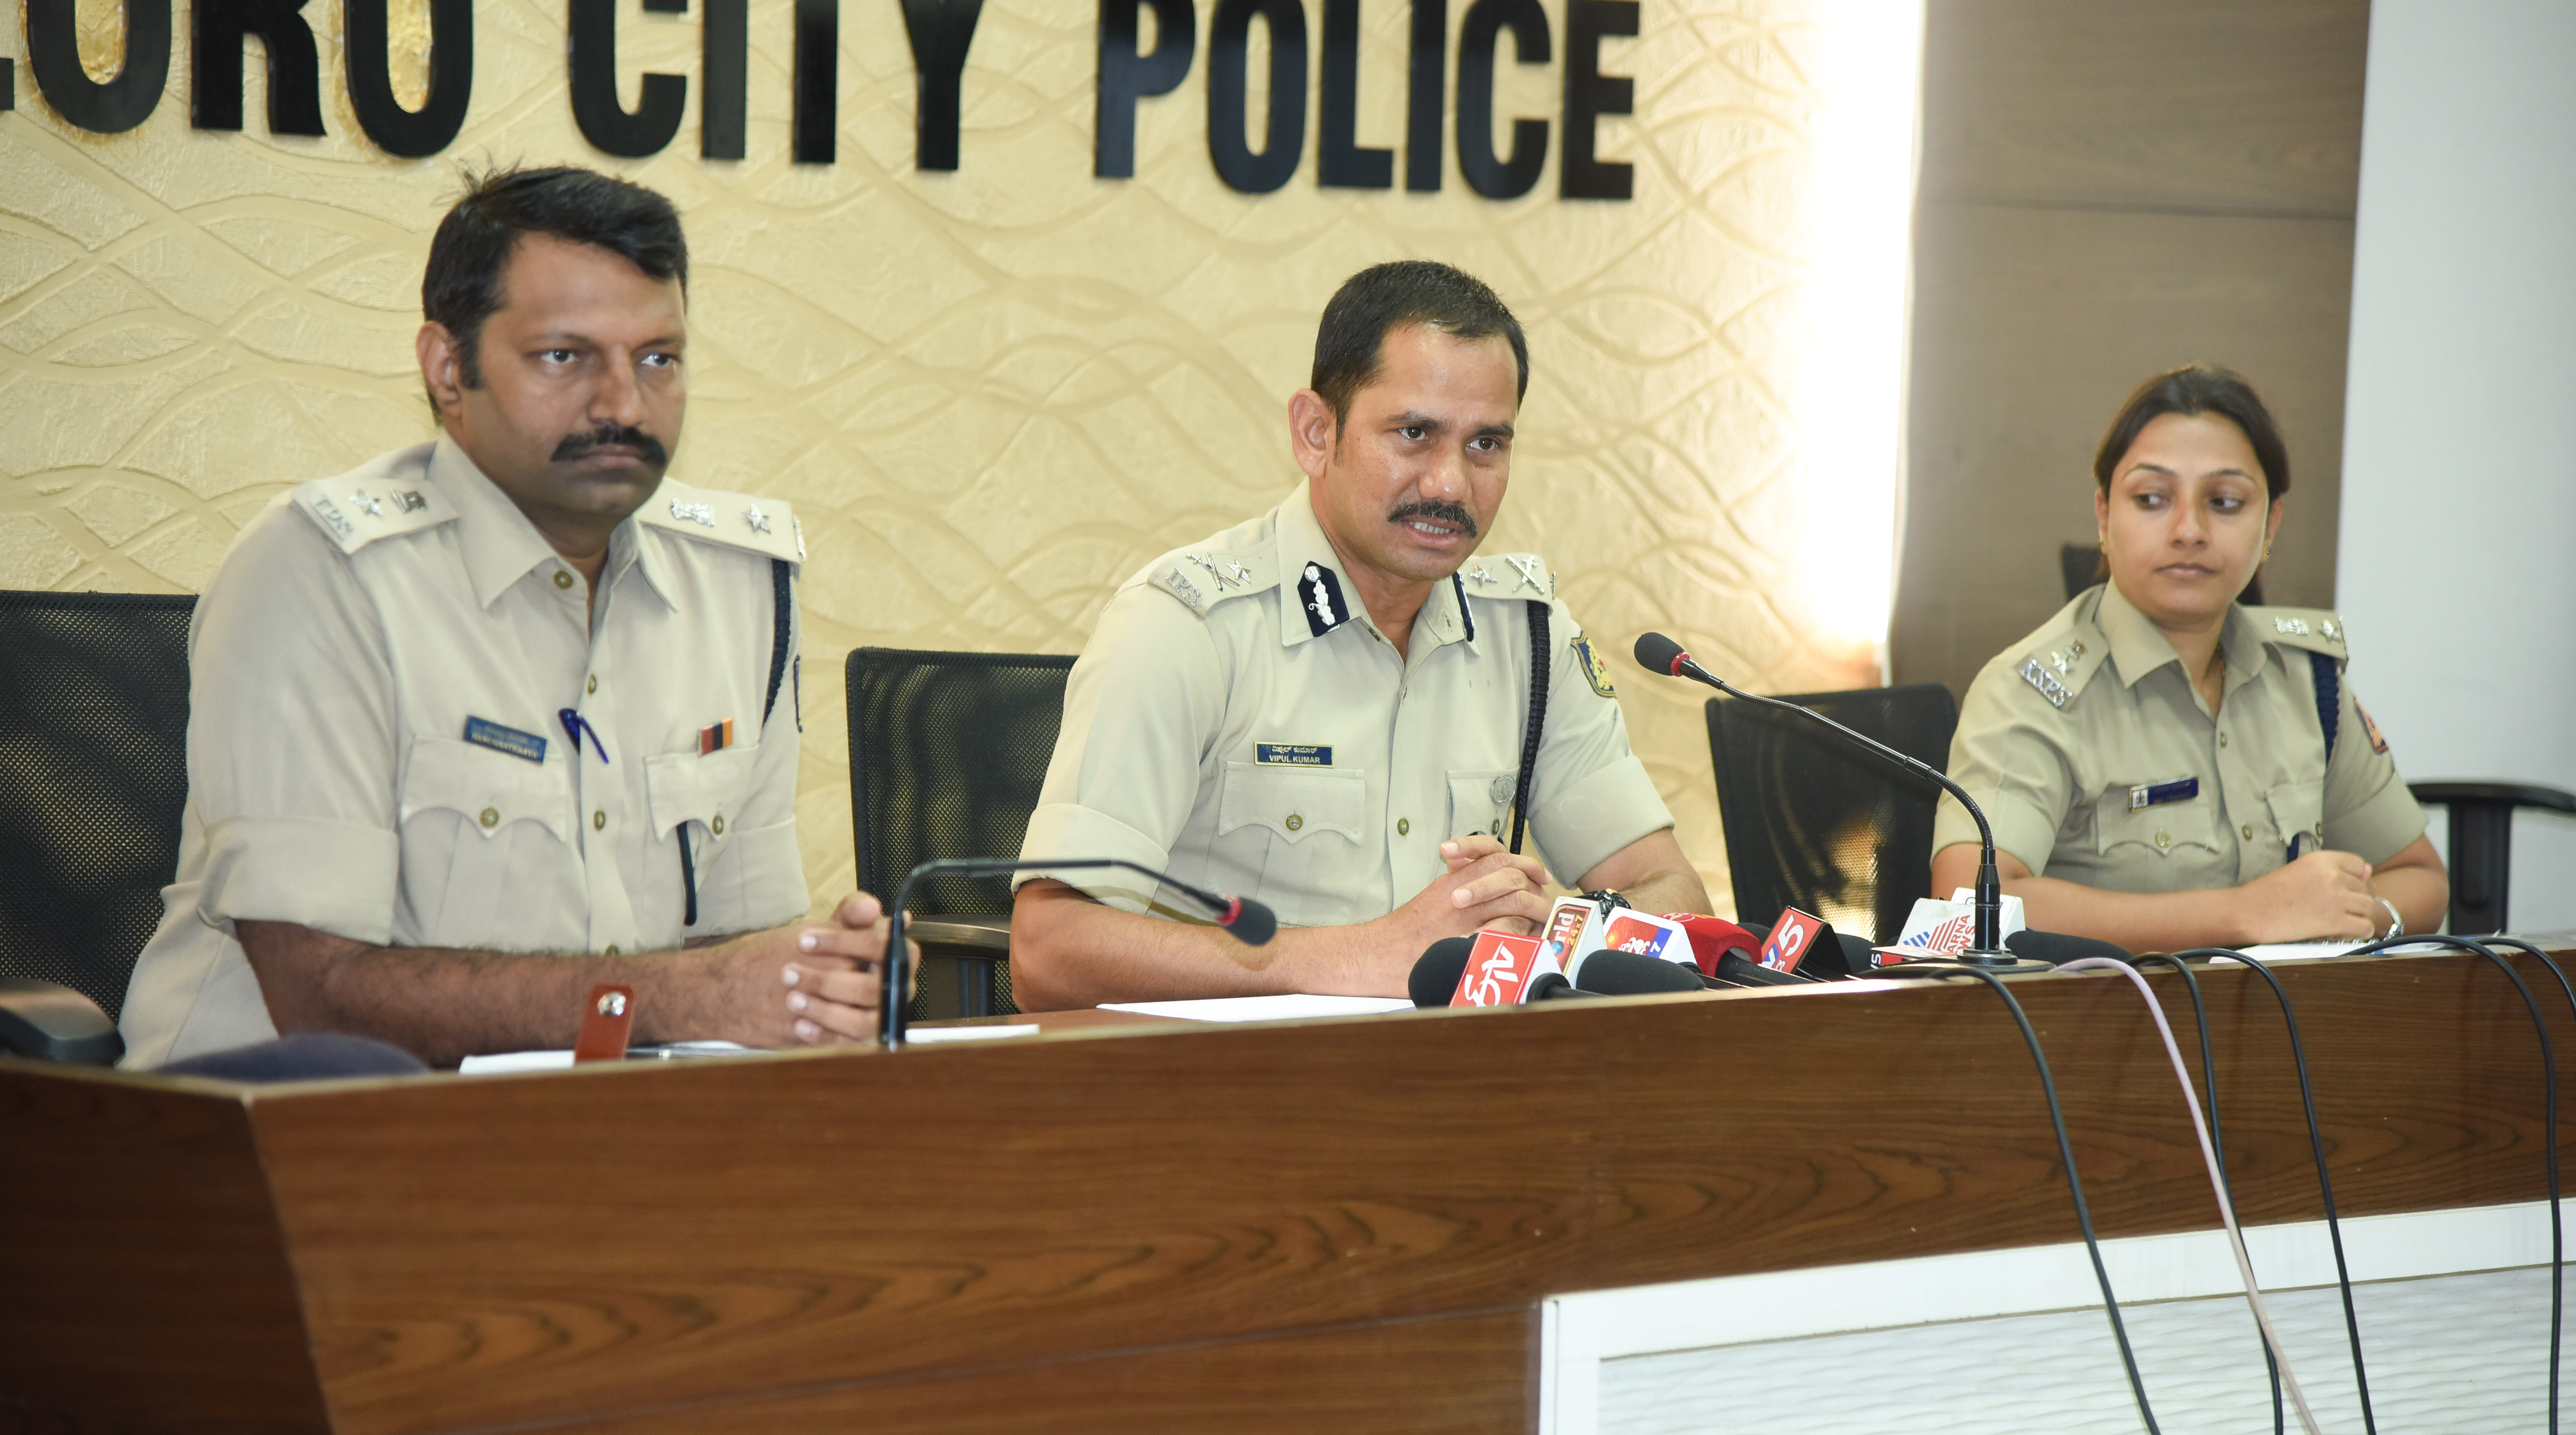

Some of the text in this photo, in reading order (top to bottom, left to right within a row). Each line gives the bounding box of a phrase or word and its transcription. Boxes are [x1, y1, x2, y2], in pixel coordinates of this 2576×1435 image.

[0, 0, 472, 158] URU
[1094, 0, 1639, 201] POLICE
[1165, 566, 1202, 607] IPS
[2018, 659, 2072, 708] KSPS
[1947, 915, 1971, 953] ARNA
[1955, 925, 1976, 953] WS
